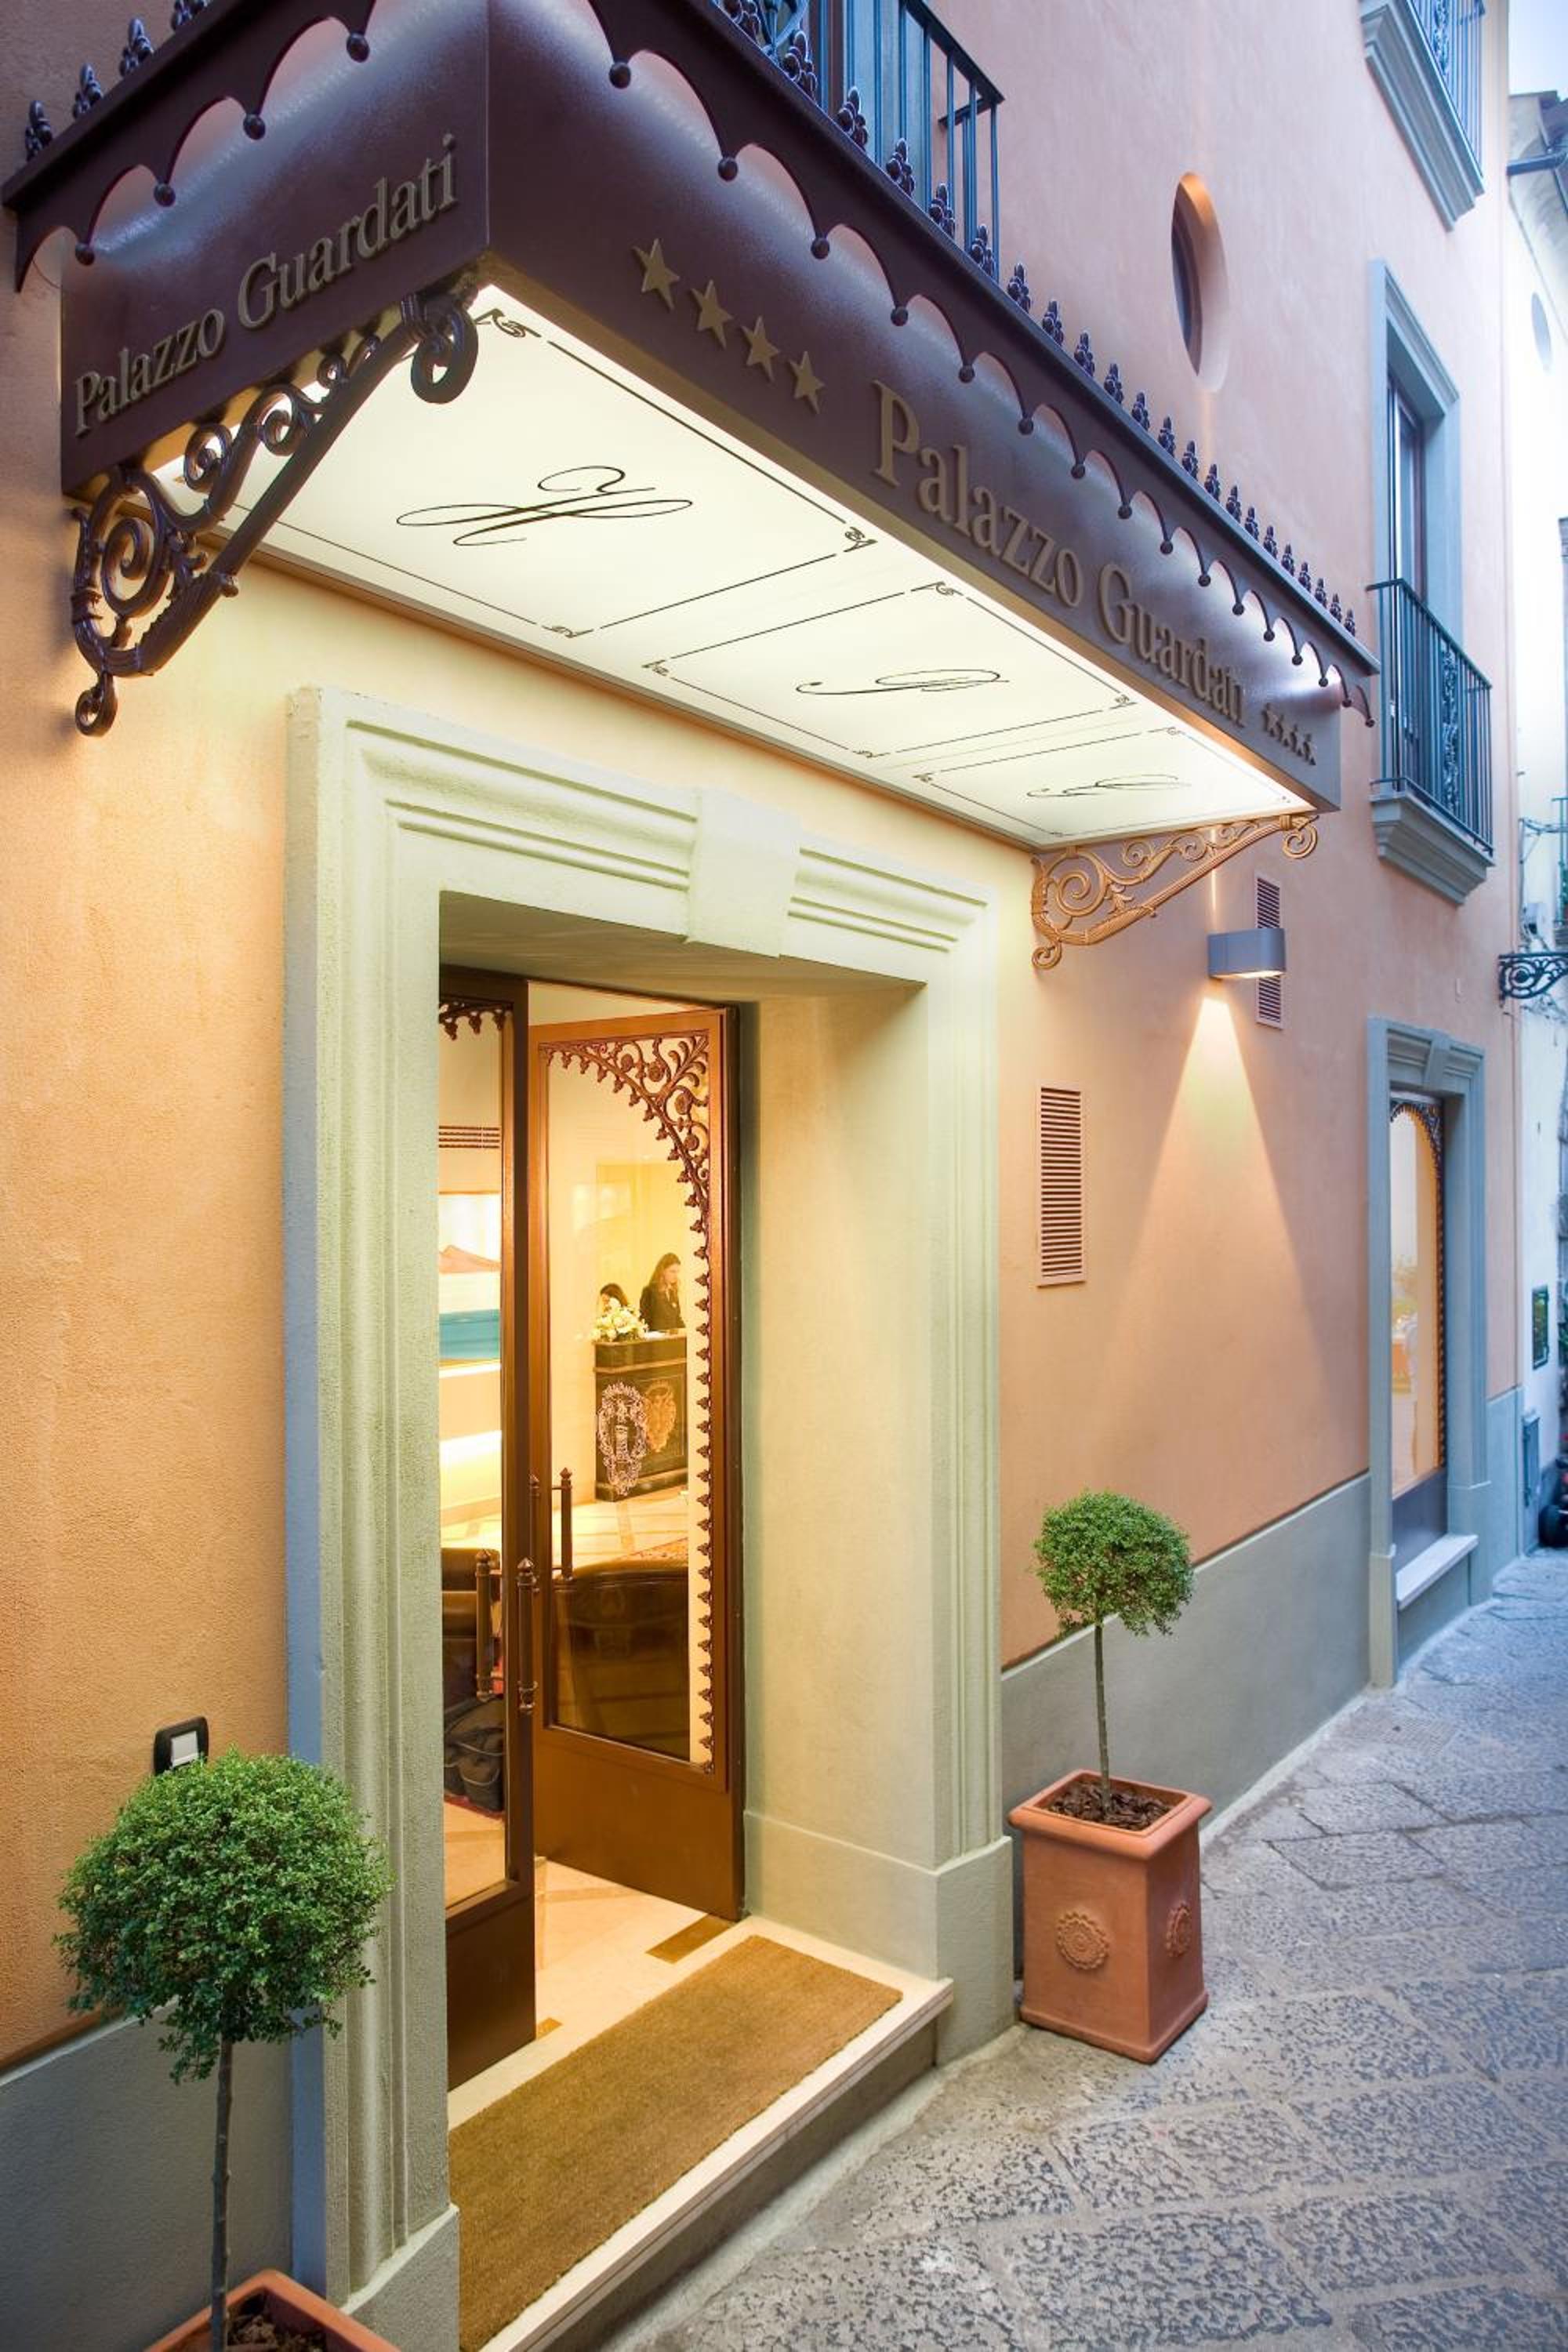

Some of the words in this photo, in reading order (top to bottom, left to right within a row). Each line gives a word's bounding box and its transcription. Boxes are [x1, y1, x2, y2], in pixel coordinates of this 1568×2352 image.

[75, 307, 226, 437] Palazzo
[238, 132, 458, 328] Guardati
[873, 380, 1084, 608] Palazzo
[1099, 564, 1245, 728] Guardati
